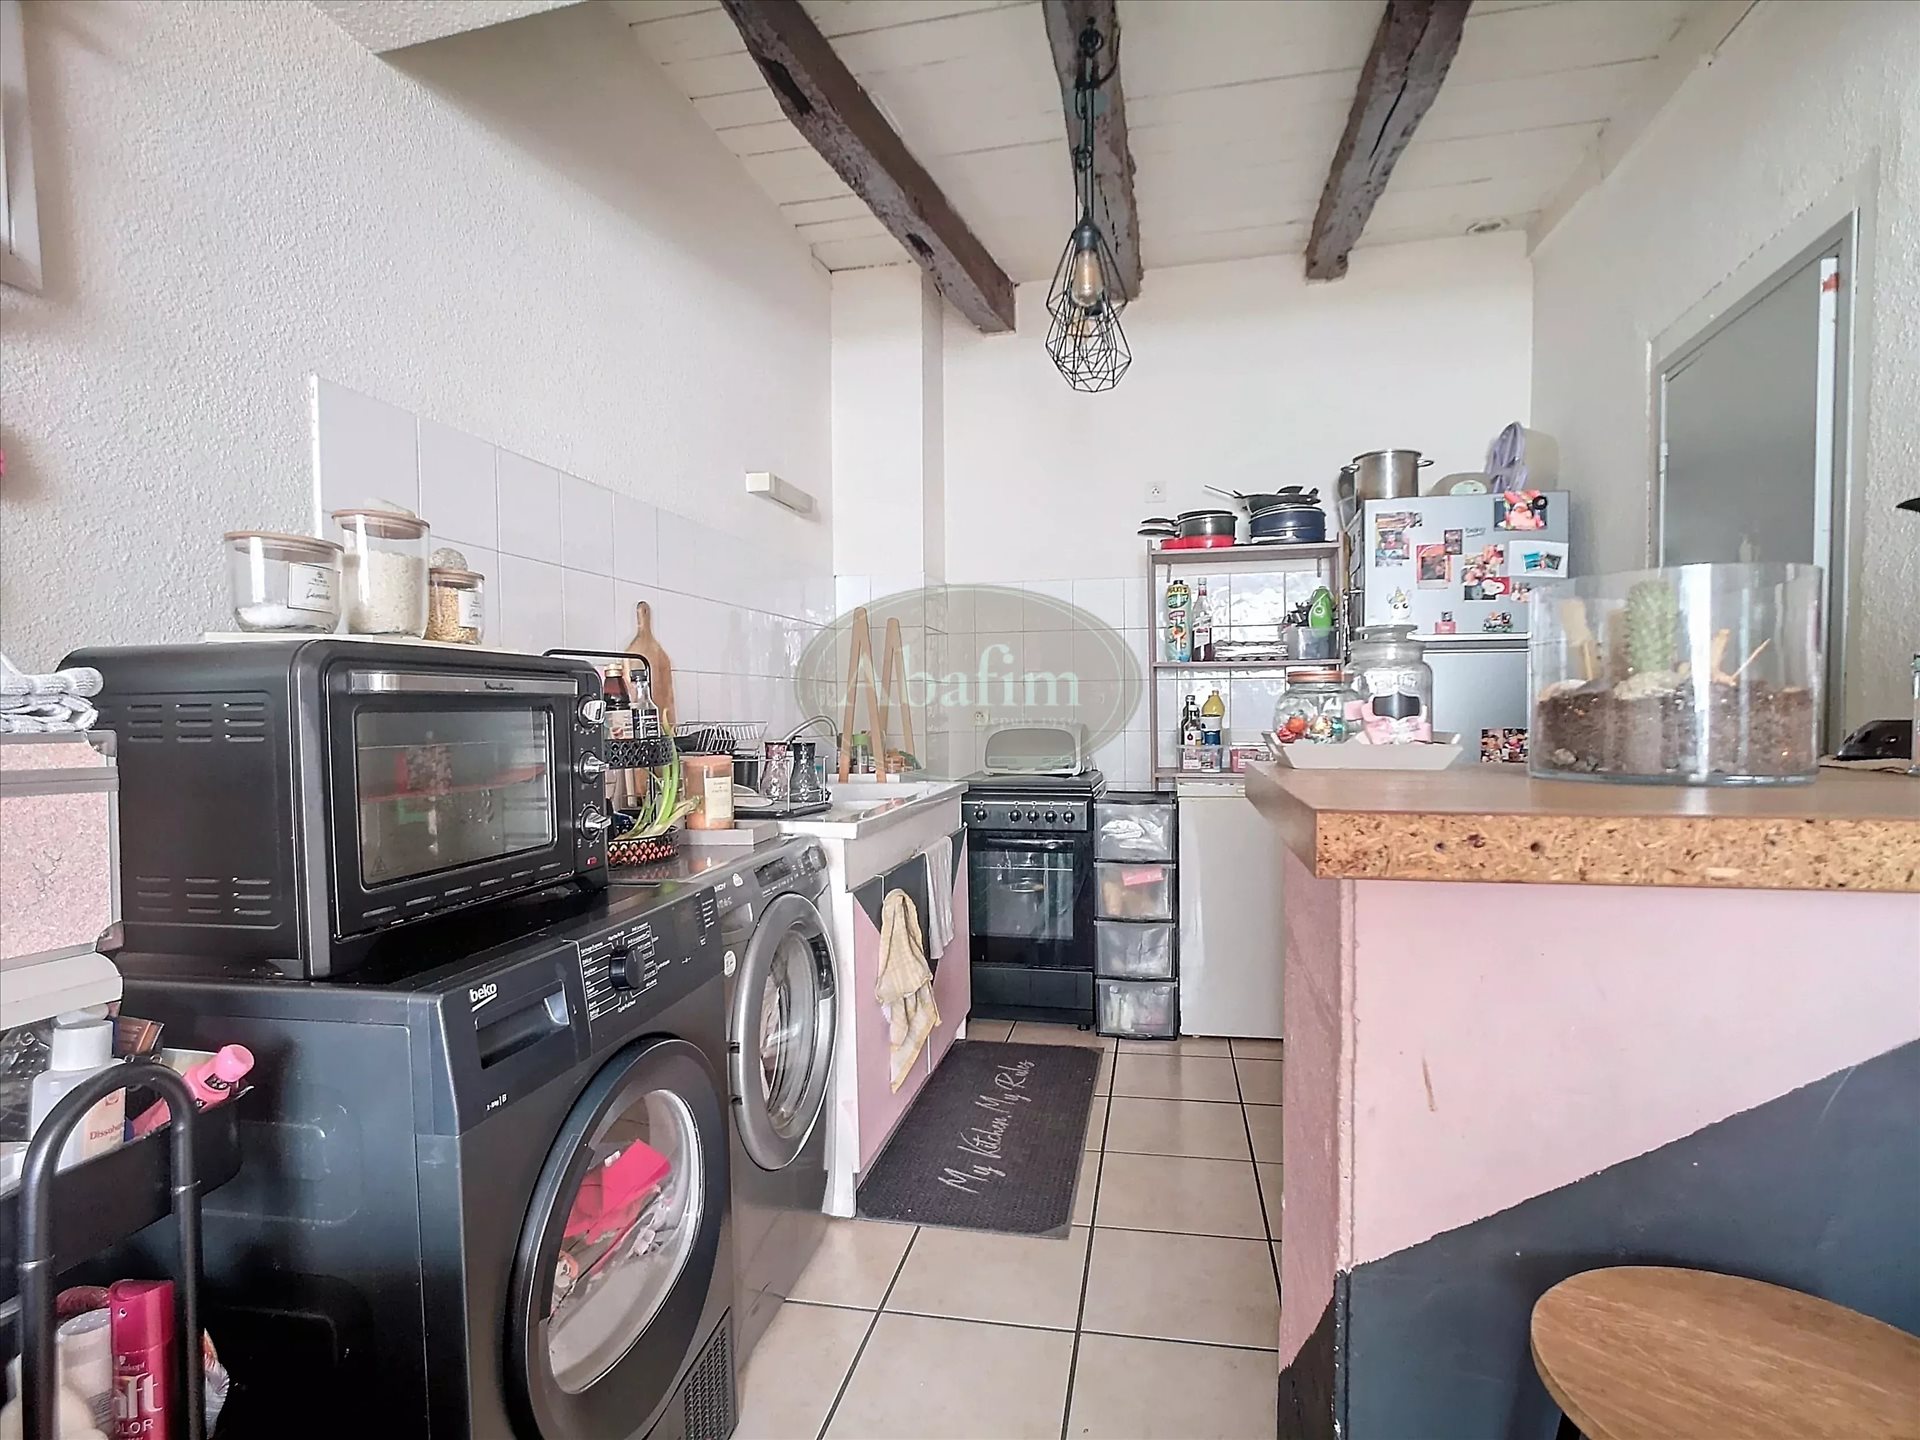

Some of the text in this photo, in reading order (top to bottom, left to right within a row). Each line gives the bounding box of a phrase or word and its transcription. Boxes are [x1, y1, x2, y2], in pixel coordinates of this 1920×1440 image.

[469, 983, 498, 1003] beko
[995, 1059, 1036, 1090] Rules
[975, 1093, 1032, 1113] My
[938, 1165, 1006, 1193] My
[112, 1372, 163, 1419] aft
